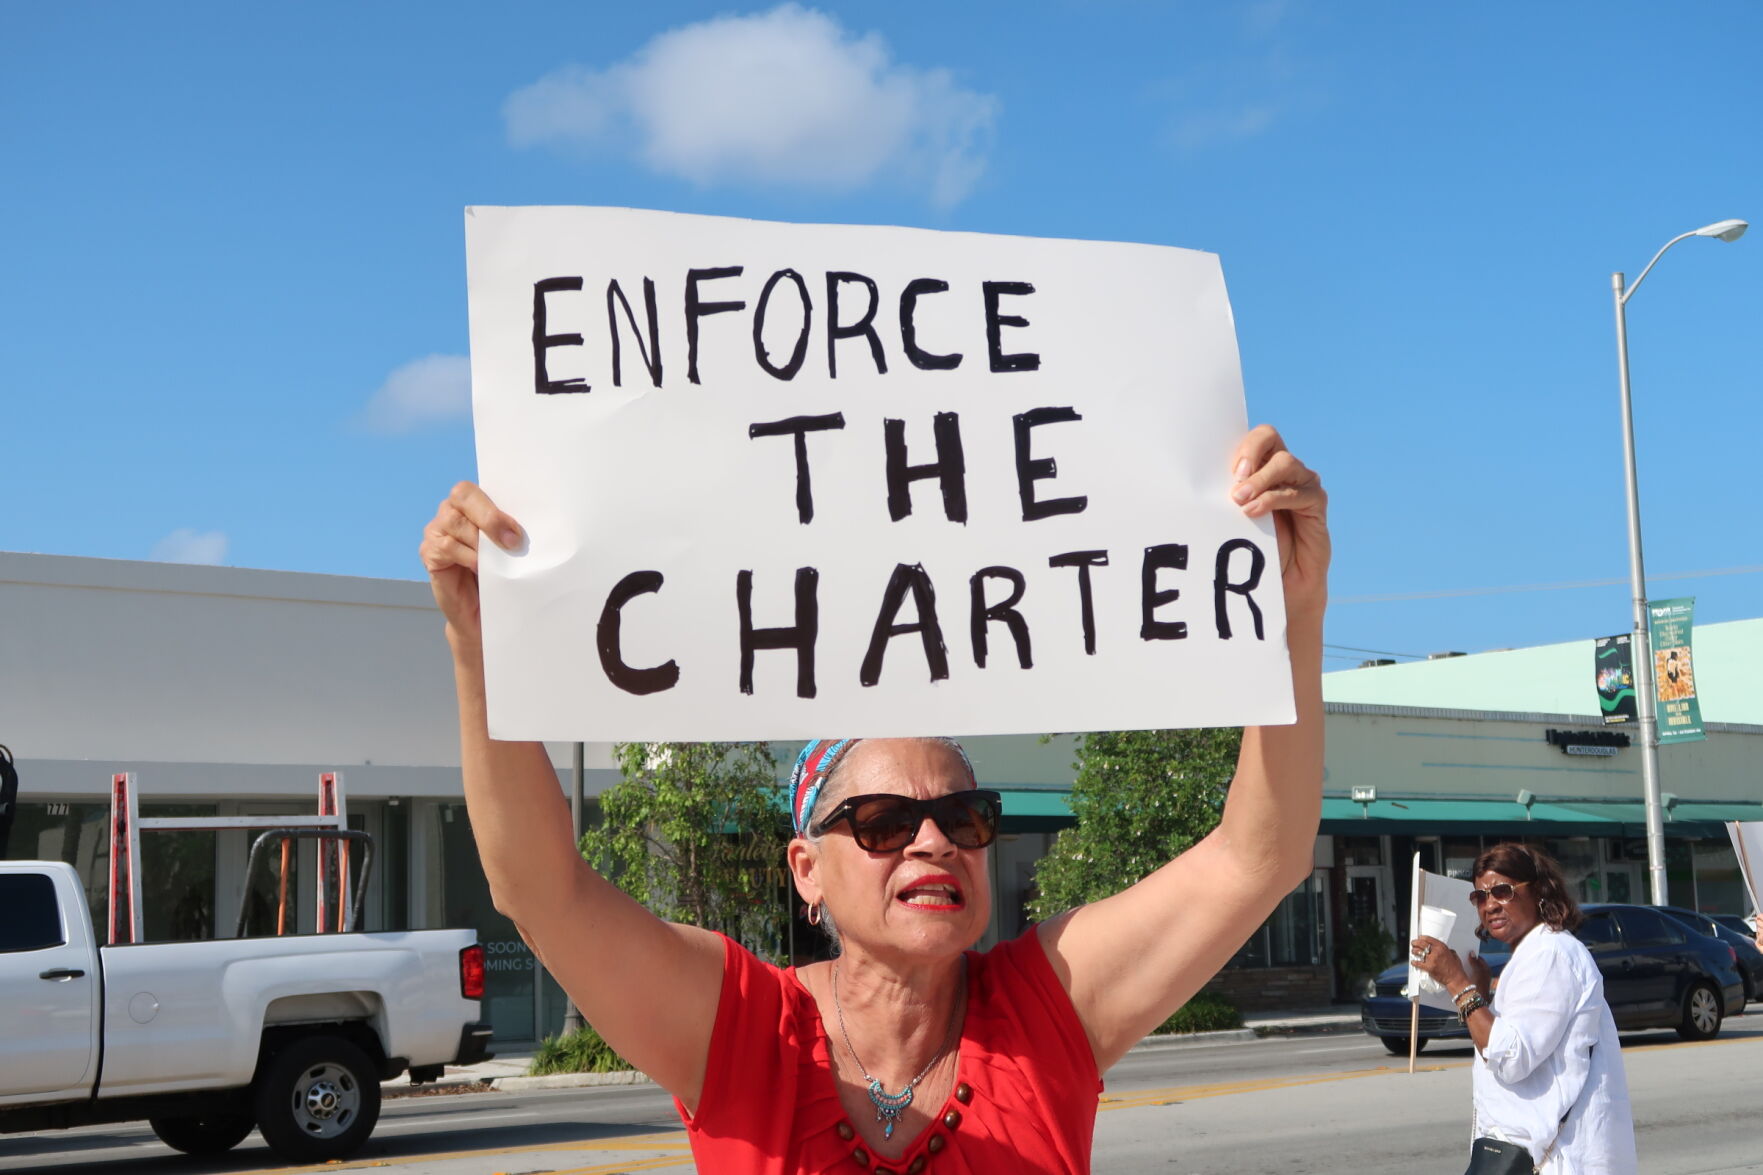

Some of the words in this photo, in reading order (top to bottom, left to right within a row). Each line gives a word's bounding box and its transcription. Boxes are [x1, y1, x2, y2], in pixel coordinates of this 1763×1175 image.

[532, 266, 1041, 395] ENFORCE
[748, 406, 1088, 526] THE
[596, 538, 1266, 699] CHARTER
[483, 959, 522, 971] MING
[487, 942, 527, 954] SOON
